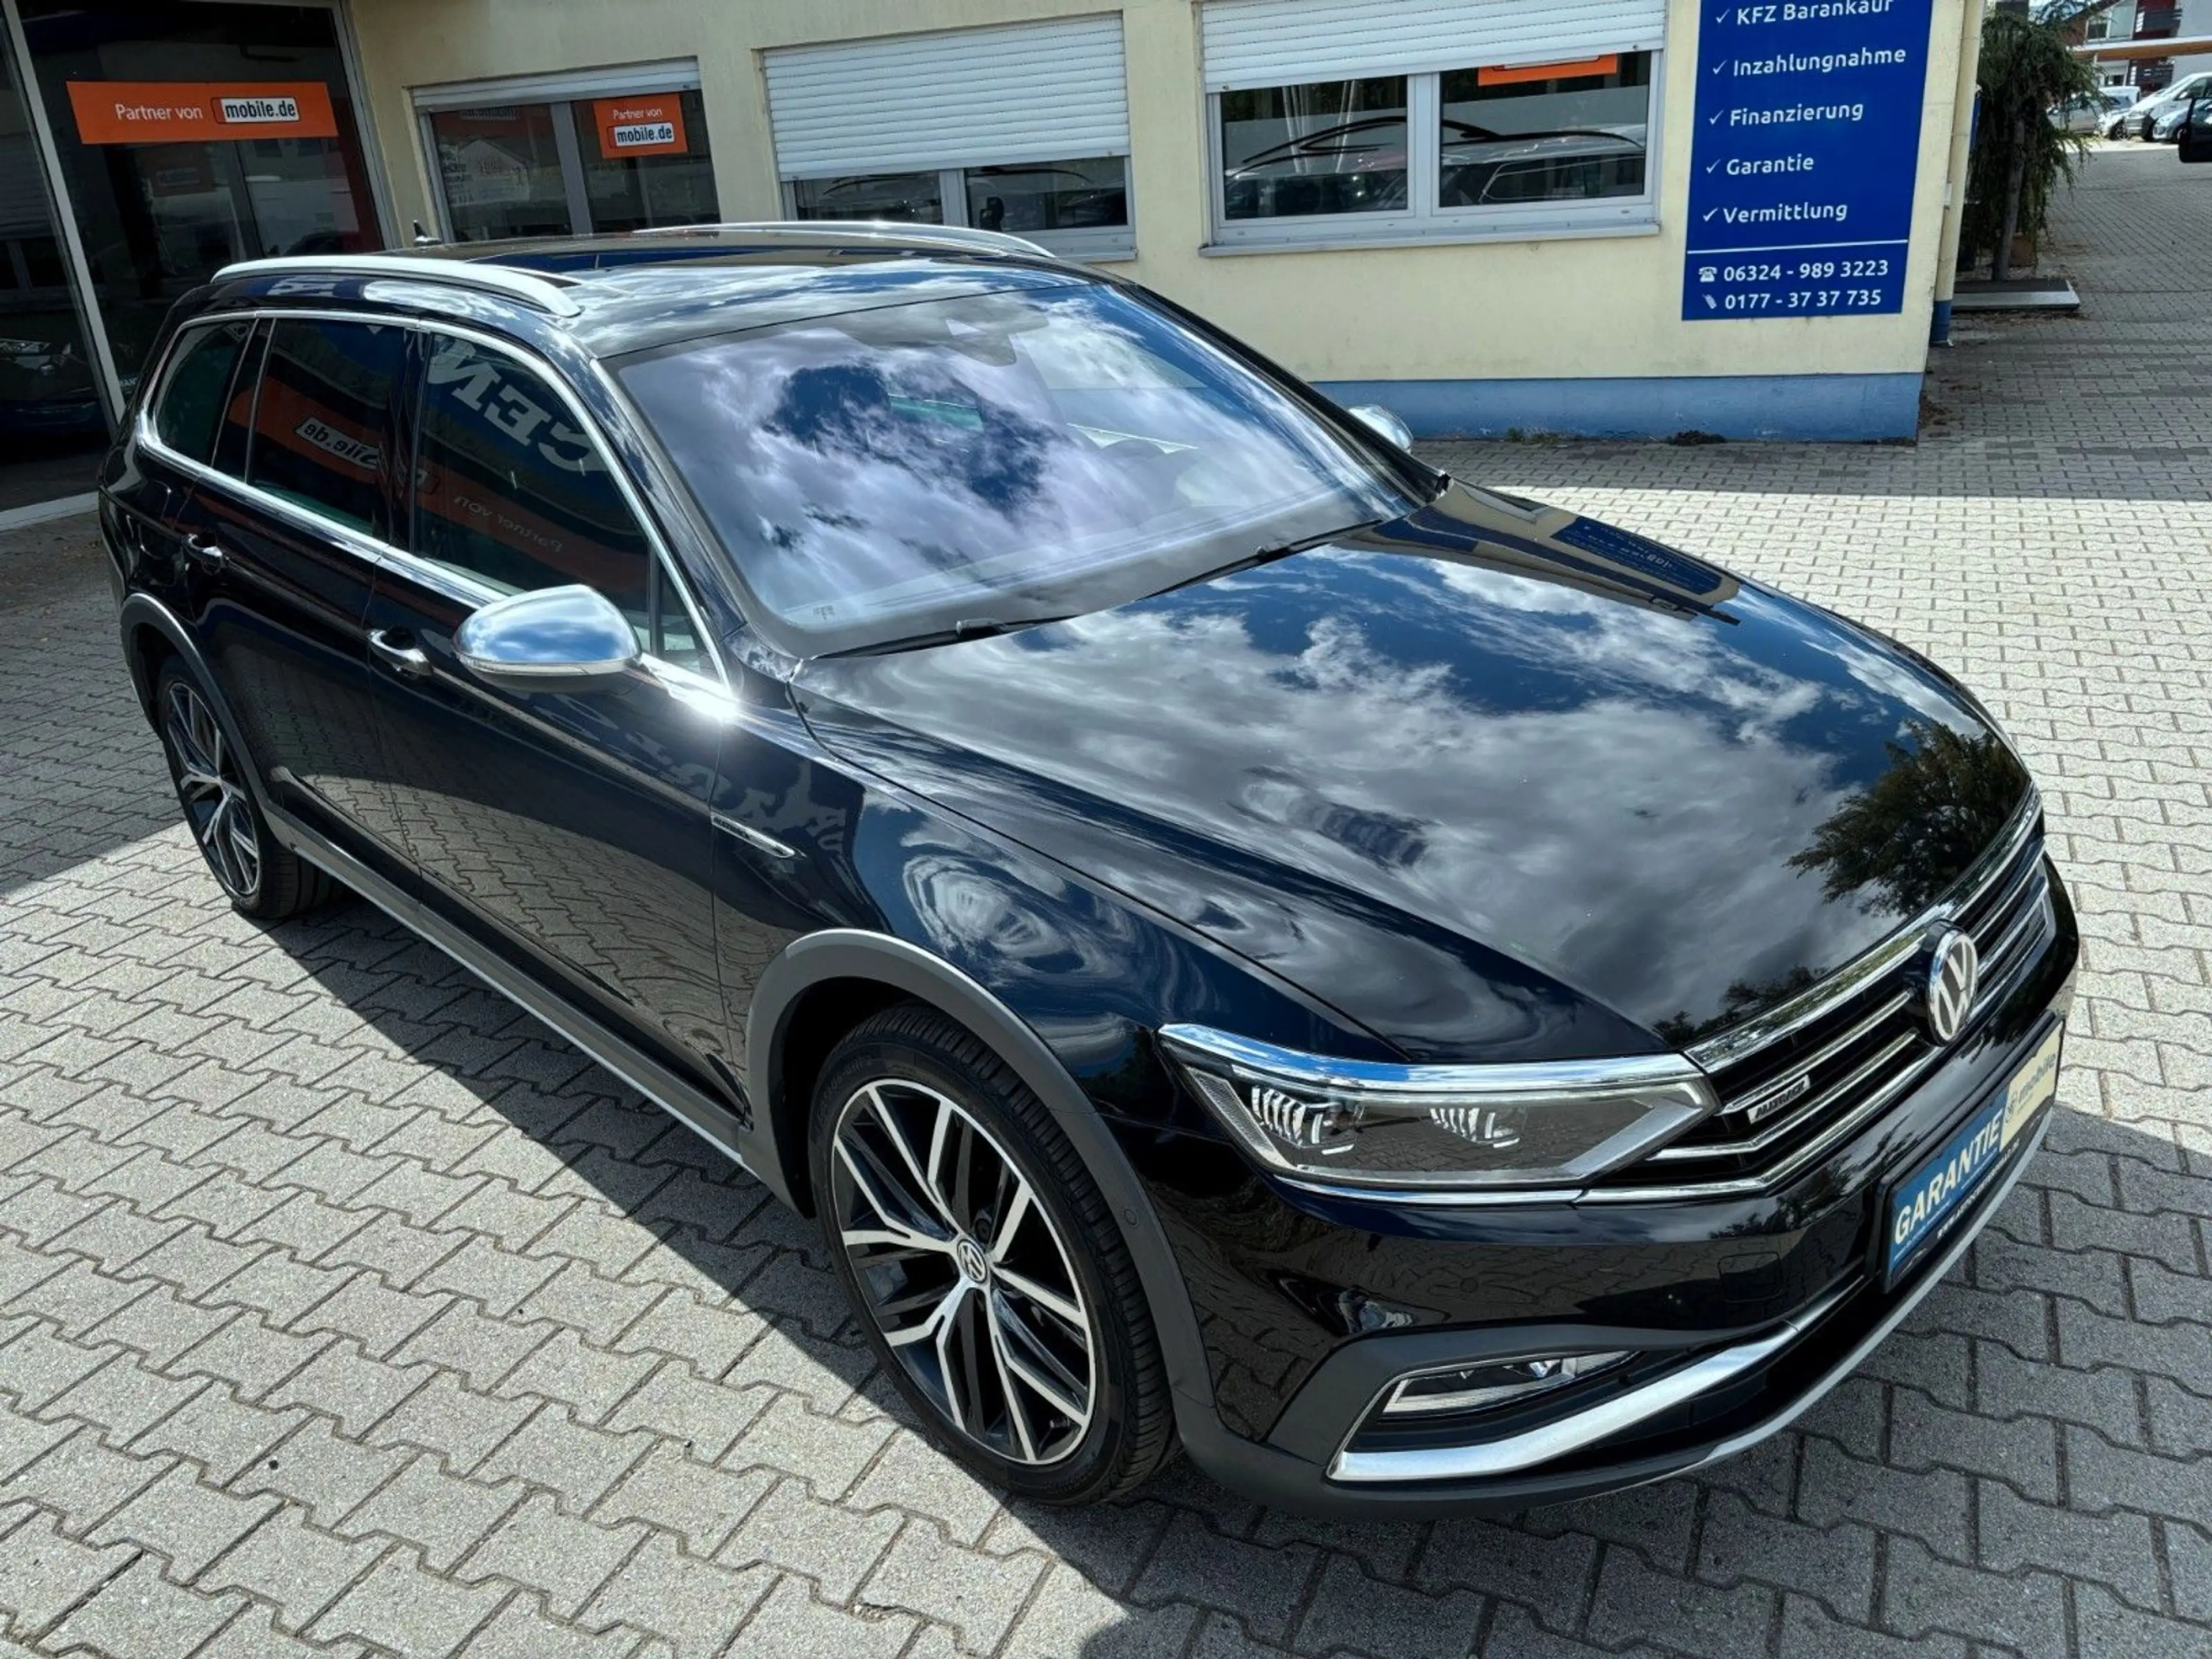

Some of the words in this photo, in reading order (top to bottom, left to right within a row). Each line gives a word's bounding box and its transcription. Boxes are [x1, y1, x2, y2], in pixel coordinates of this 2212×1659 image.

[1737, 5, 1777, 25] KFZ
[1733, 47, 1906, 77] Inzahlungnahme
[115, 103, 171, 122] Partner
[175, 105, 203, 120] von
[225, 100, 296, 119] mobile.de
[613, 108, 643, 120] Partner
[646, 108, 662, 118] von
[1730, 104, 1864, 127] Finanzierung
[616, 125, 673, 143] mobile.de
[1726, 154, 1815, 175] Garantie
[1723, 202, 1848, 224] Vermittlung
[1724, 263, 1782, 282] 06324
[1799, 262, 1834, 279] 989
[1840, 259, 1889, 278] 3223
[1725, 293, 1770, 310] 0177
[1787, 291, 1812, 308] 37
[1816, 290, 1841, 307] 37
[1847, 289, 1882, 306] 735
[1895, 1108, 2003, 1244] GARANTIE
